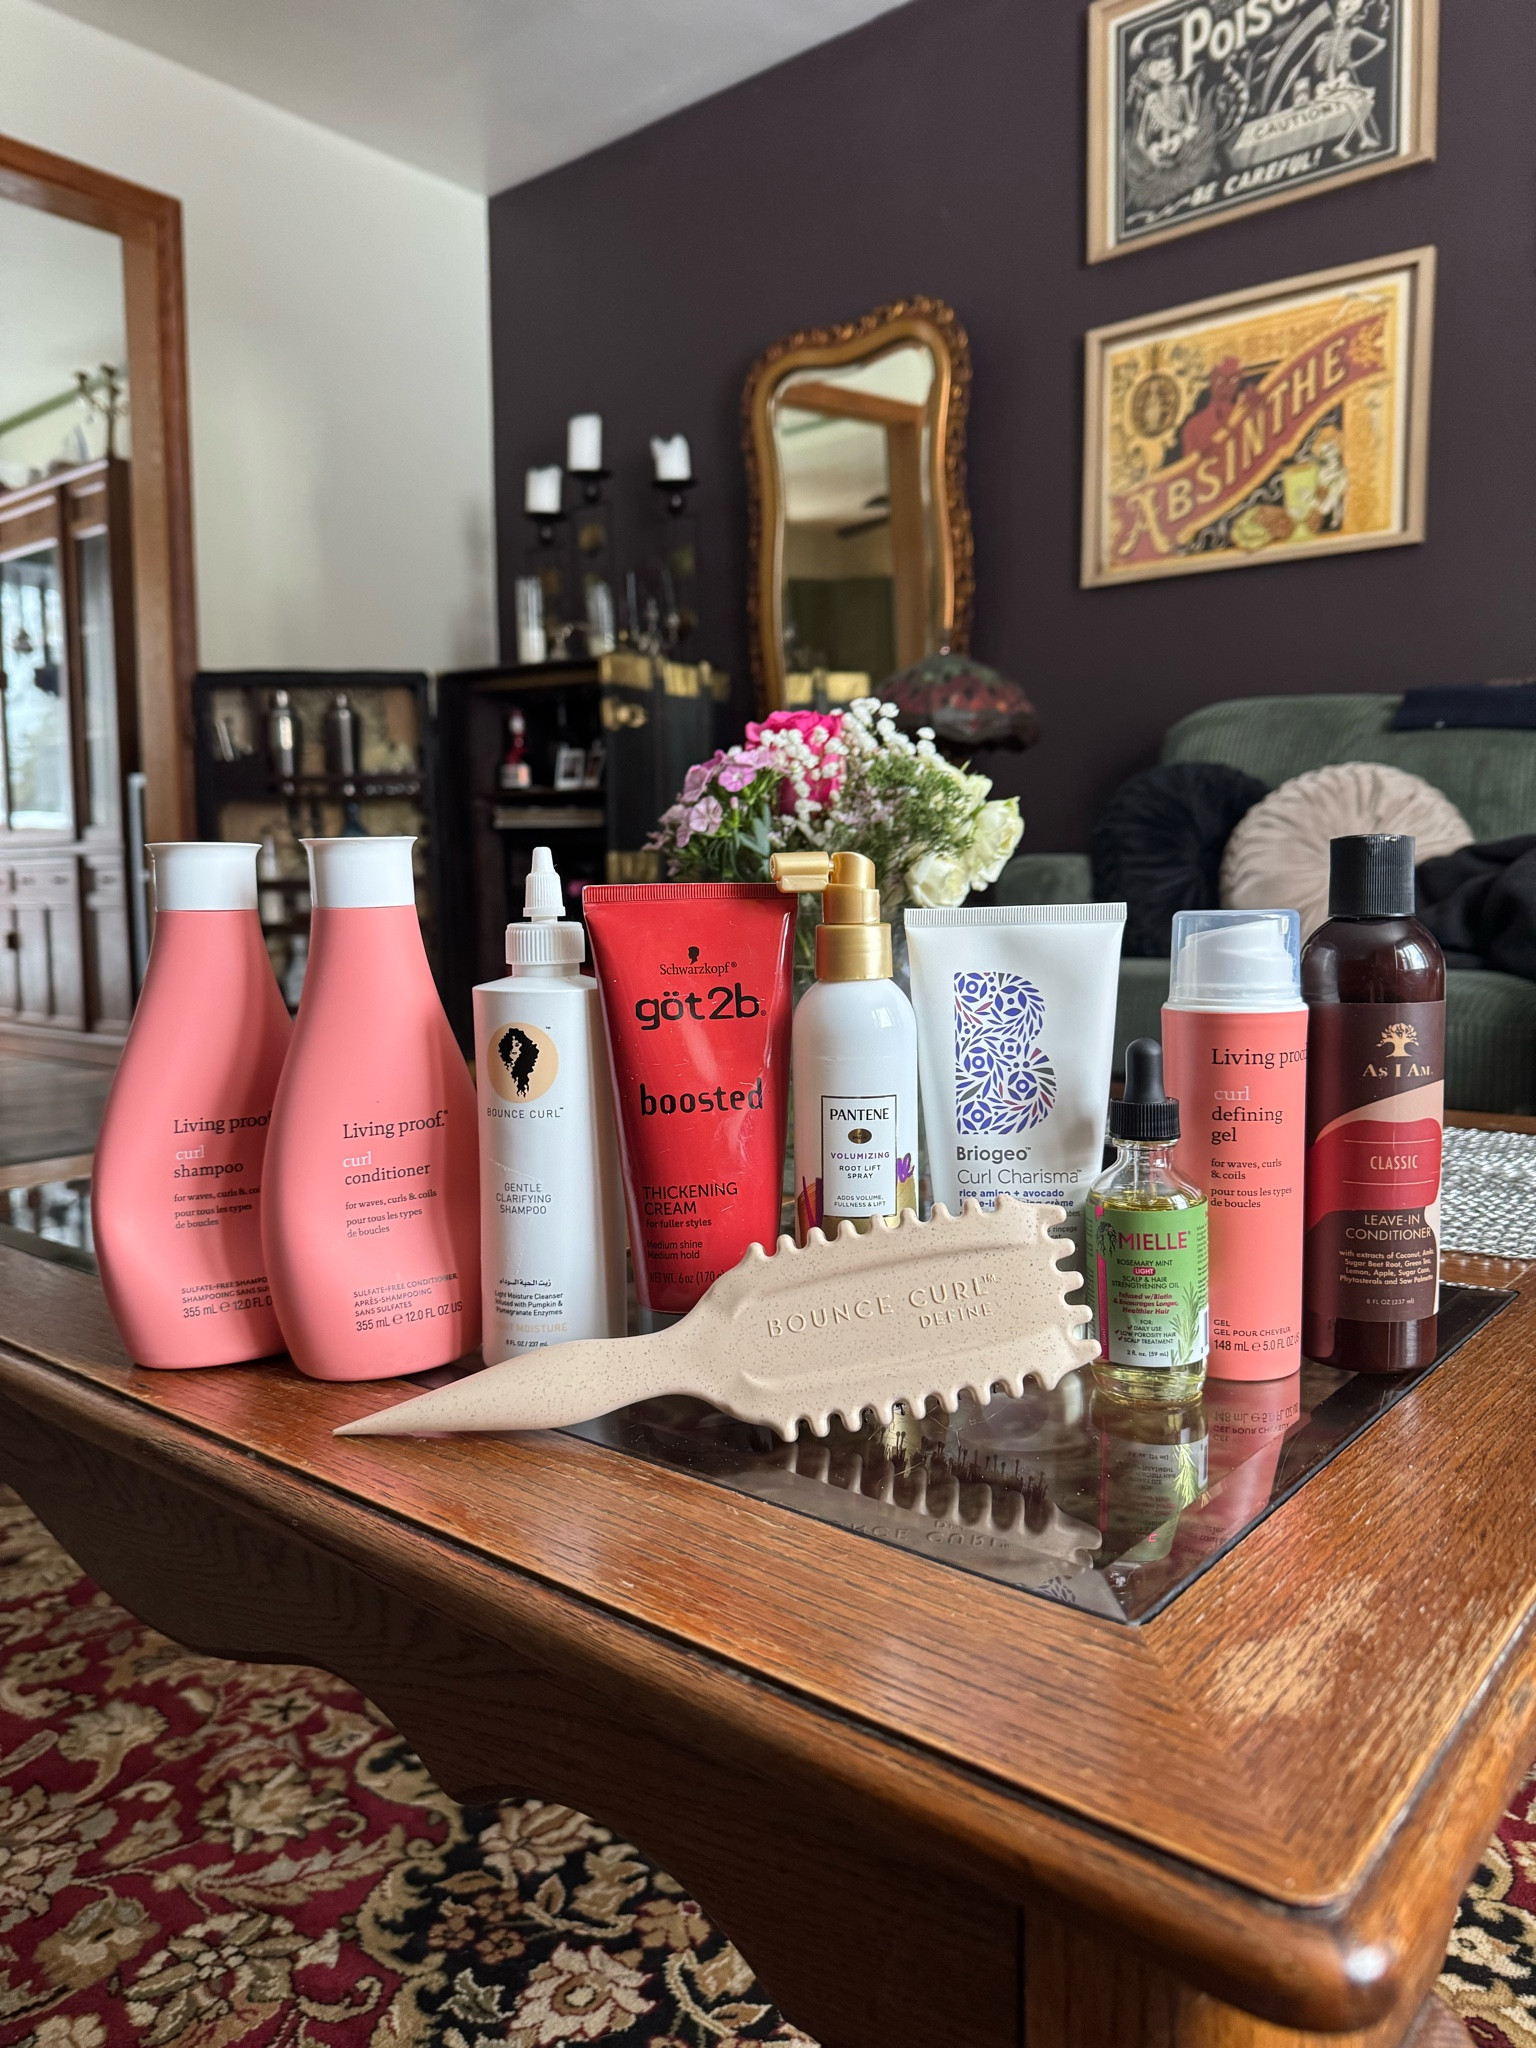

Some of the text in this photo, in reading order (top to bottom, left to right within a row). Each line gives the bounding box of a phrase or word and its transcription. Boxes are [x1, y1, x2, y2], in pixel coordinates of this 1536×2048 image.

[1188, 180, 1219, 207] BE
[1118, 336, 1348, 555] ABSINTHE
[1212, 1048, 1275, 1069] Living
[1395, 1064, 1401, 1077] I
[640, 1077, 762, 1116] boosted
[1214, 1086, 1250, 1101] curl
[487, 1108, 524, 1118] BOUNCE
[830, 1108, 889, 1120] PANTENE
[1212, 1106, 1283, 1124] defining
[174, 1118, 225, 1134] Living
[344, 1122, 394, 1138] Living
[1211, 1127, 1237, 1145] gel
[176, 1145, 204, 1160] curl
[343, 1151, 372, 1168] curl
[1211, 1158, 1281, 1169] for waves, curls
[1370, 1155, 1418, 1169] CLASSIC
[174, 1163, 243, 1178] shampoo
[345, 1165, 430, 1185] conditioner
[958, 1169, 991, 1184] Curl
[1223, 1171, 1246, 1180] coils
[505, 1183, 541, 1192] GENTLE
[642, 1182, 737, 1199] THICKENING
[959, 1189, 1064, 1197] rice avocado
[1211, 1187, 1292, 1198] pour tous les types
[174, 1194, 186, 1202] for
[188, 1192, 216, 1200] waves,
[345, 1202, 357, 1210] for
[358, 1199, 386, 1208] waves,
[388, 1194, 407, 1203] curls
[418, 1189, 437, 1199] coils
[497, 1193, 551, 1203] CLARIFYING
[1211, 1199, 1261, 1208] de boucles
[175, 1211, 195, 1219] pour
[229, 1204, 252, 1213] types
[500, 1205, 547, 1215] SHAMPOO
[644, 1201, 696, 1215] CREAM
[187, 1218, 218, 1228] boucles
[346, 1217, 365, 1227] pour
[400, 1209, 422, 1219] types
[646, 1218, 712, 1228] For fuller styles
[1365, 1214, 1420, 1225] LEAVE-IN
[359, 1225, 389, 1236] boucles
[1346, 1228, 1431, 1240] CONDITIONER
[647, 1240, 702, 1249] Medium shine
[647, 1250, 700, 1259] Medium hold
[1345, 1259, 1365, 1267] Sugar
[1346, 1268, 1370, 1276] Lemon,
[354, 1273, 457, 1298] SULFATE-FREE CONDITIONER
[1112, 1281, 1167, 1289] STRENGTHENING
[1340, 1275, 1382, 1284] Phytosterols
[181, 1283, 234, 1294] SULFATE-FREE
[183, 1287, 256, 1303] SHAMPOOING SANS
[355, 1288, 432, 1307] APRÈS-SHAMPOOING
[184, 1298, 263, 1318] 355 mL 12.0 FL
[355, 1301, 412, 1316] SANS SULFATES
[534, 1309, 562, 1317] Enzymes
[356, 1301, 463, 1331] 355 mL 12.0 FL OZ US
[768, 1294, 894, 1337] BOUNCE
[919, 1303, 994, 1328] DEFINE
[1260, 1327, 1291, 1336] CHEVEUX
[1214, 1340, 1231, 1350] 148
[1234, 1341, 1249, 1351] mL
[1263, 1340, 1275, 1350] 5.0
[1277, 1339, 1284, 1348] FL
